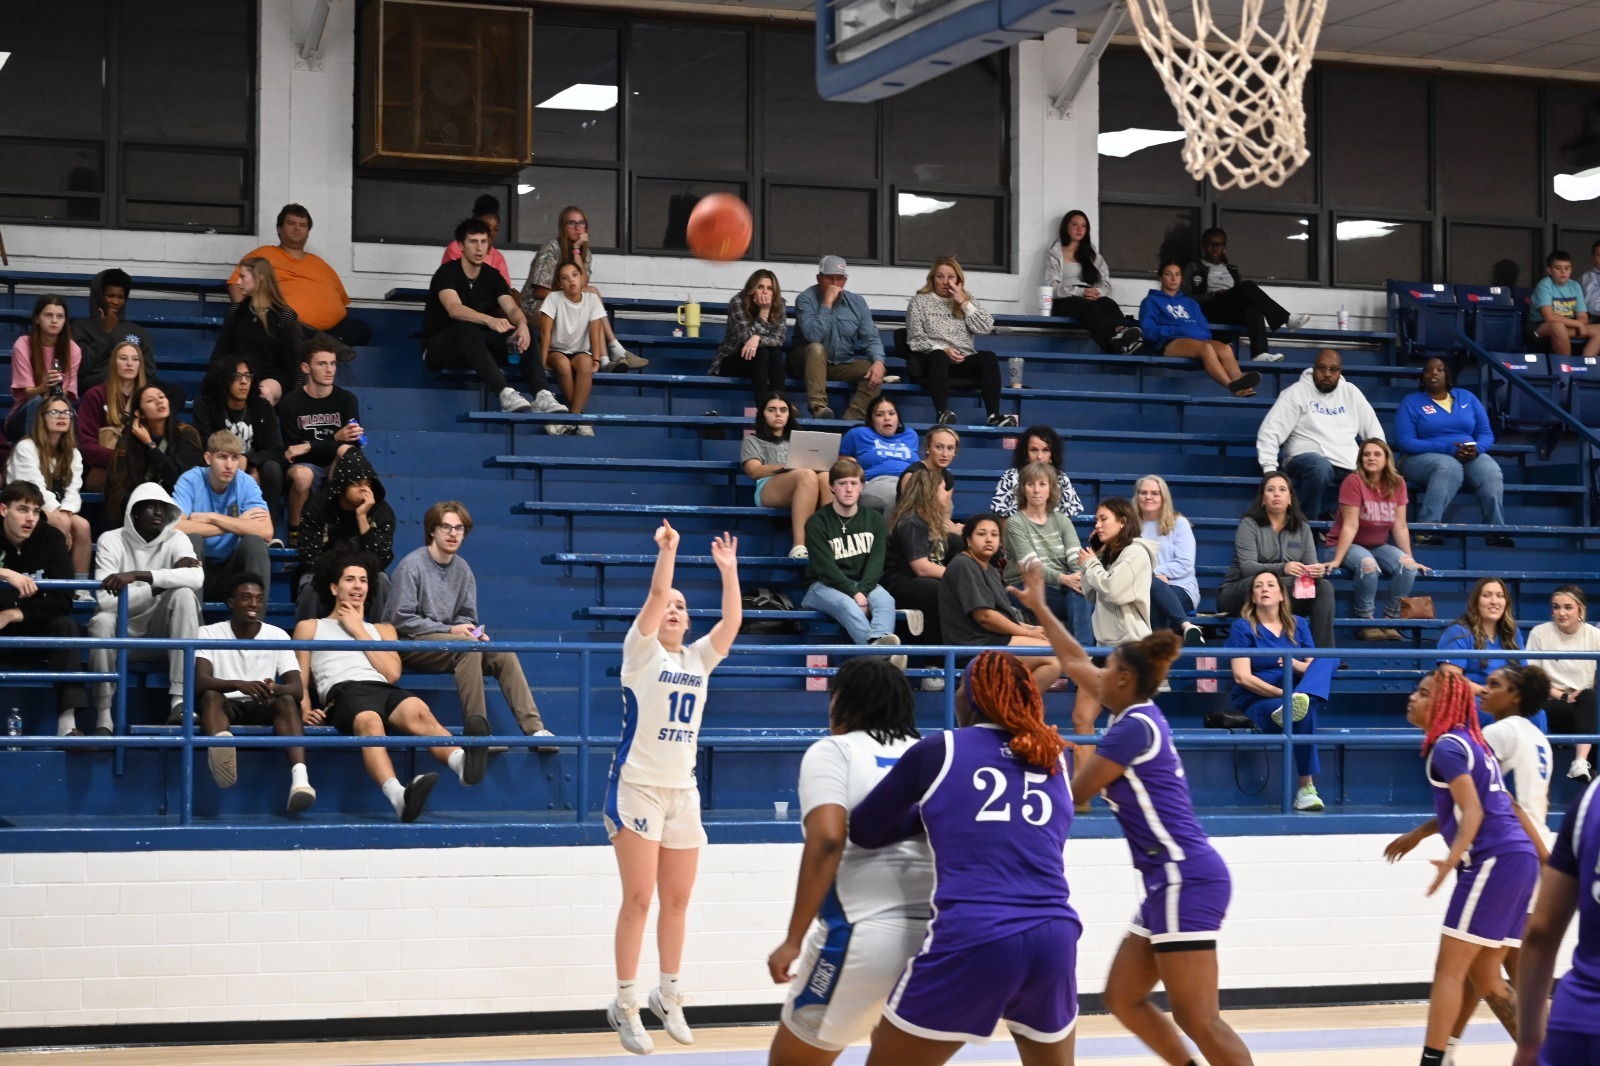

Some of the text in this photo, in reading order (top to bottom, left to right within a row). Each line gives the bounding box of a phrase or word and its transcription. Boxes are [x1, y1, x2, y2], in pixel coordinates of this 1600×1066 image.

[668, 690, 697, 724] 10
[657, 727, 695, 743] STATE
[1536, 744, 1548, 780] 5
[973, 766, 1053, 826] 25
[809, 958, 836, 998] AGGIES
